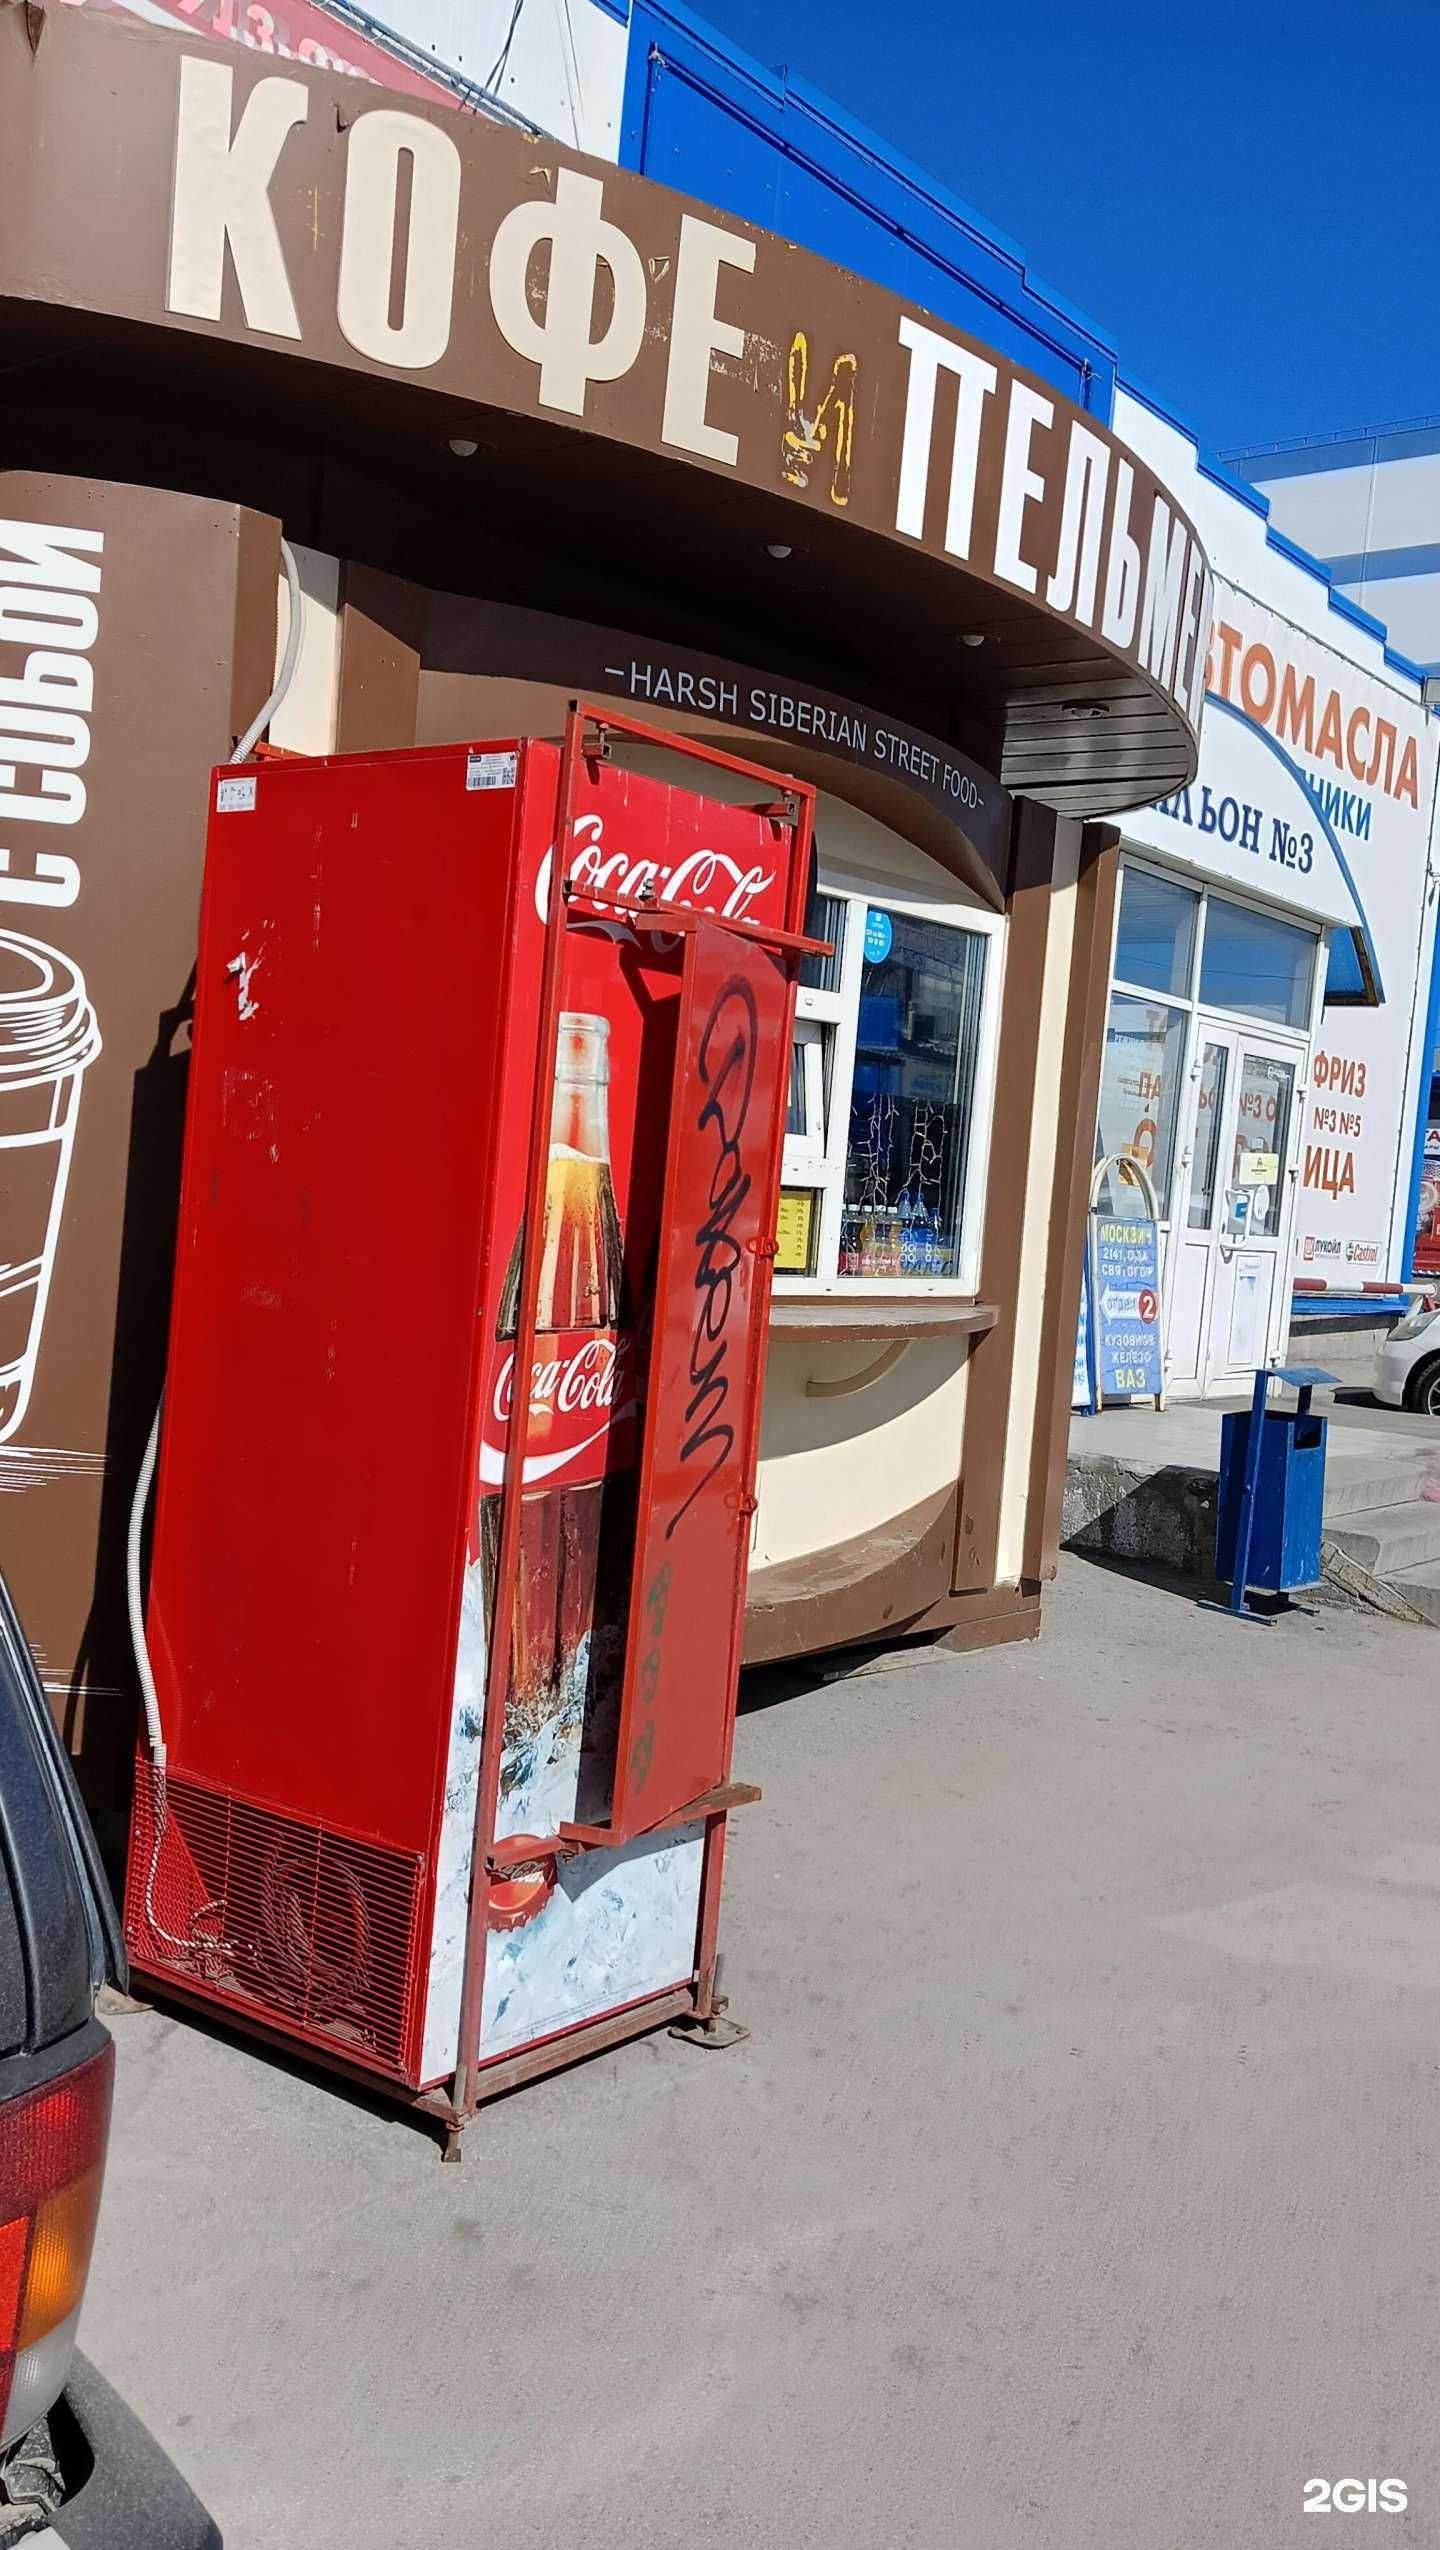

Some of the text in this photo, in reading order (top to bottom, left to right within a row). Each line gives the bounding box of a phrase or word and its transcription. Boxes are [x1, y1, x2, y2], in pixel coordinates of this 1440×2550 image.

[166, 54, 758, 468] КОФЕ
[895, 315, 1214, 732] ПЕЛЬМЕ
[749, 688, 867, 753] SIBERIAN
[873, 729, 940, 784] STREET
[1269, 817, 1314, 874] №3
[0, 848, 81, 908] С
[1313, 1050, 1367, 1098] ФРИЗ
[1313, 1106, 1362, 1138] №3 №5
[1142, 1294, 1155, 1320] 2
[1114, 1367, 1147, 1390] ВАЗ
